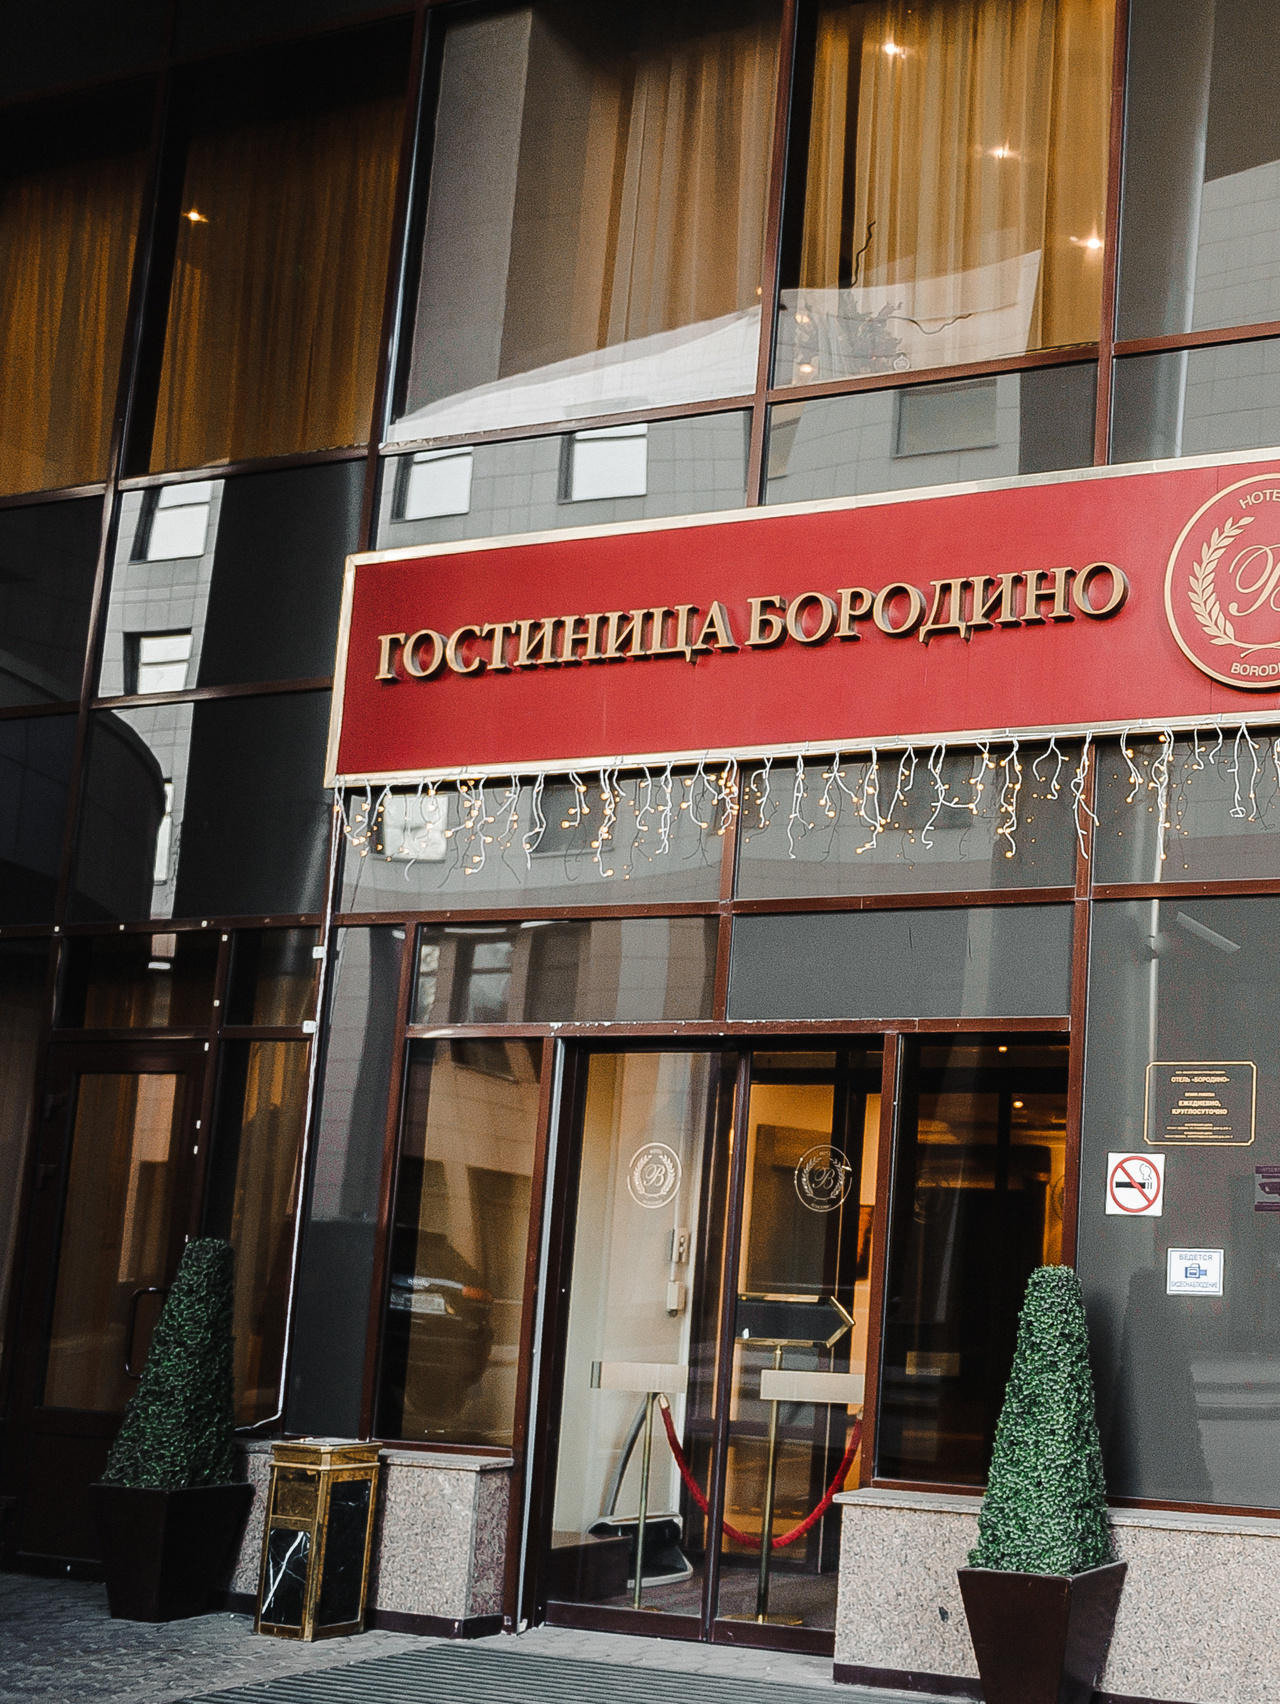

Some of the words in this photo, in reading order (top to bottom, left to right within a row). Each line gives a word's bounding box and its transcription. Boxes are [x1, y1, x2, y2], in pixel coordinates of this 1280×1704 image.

[375, 600, 740, 663] ГОСТИНИЦА
[745, 560, 1130, 644] БОРОДИНО
[1178, 1253, 1213, 1261] ВЕДЕТСЯ
